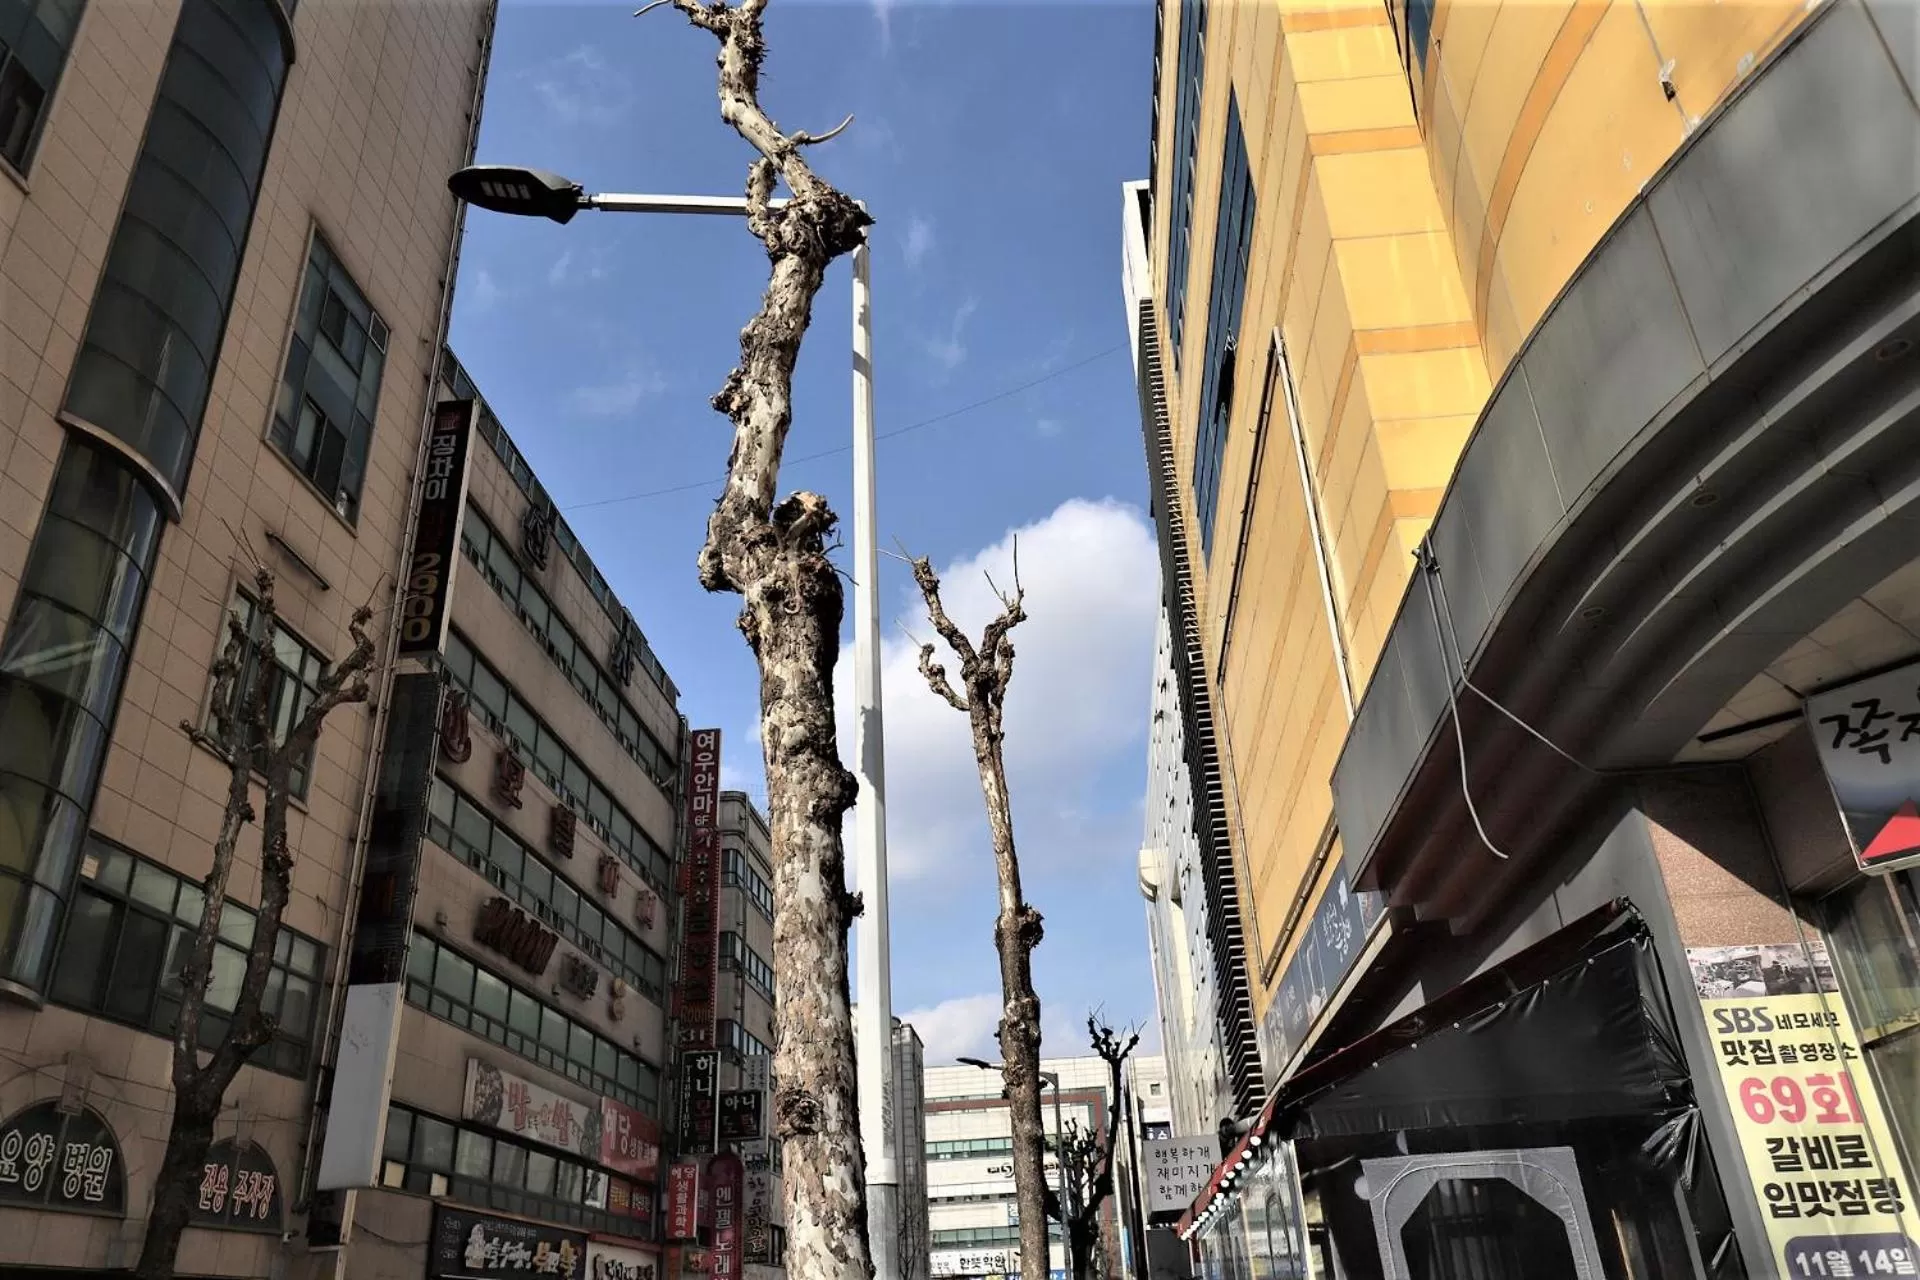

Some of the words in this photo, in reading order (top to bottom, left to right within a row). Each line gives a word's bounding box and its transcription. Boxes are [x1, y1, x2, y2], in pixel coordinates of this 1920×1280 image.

[403, 553, 441, 642] 2900
[693, 731, 715, 814] 여우안마
[1712, 1006, 1774, 1034] SBS
[1775, 1012, 1841, 1031] 네모세모
[1720, 1039, 1777, 1066] 맛집
[1778, 1042, 1859, 1065] 촬영장소
[1739, 1071, 1865, 1125] 69회
[0, 1129, 55, 1192] 요양
[63, 1142, 113, 1202] 병원
[1765, 1134, 1873, 1173] 갈비로
[198, 1163, 229, 1214] 전용
[233, 1169, 275, 1220] 주차장
[1763, 1177, 1905, 1219] 입맛점령
[714, 1186, 734, 1280] 엔젤노래
[1795, 1250, 1854, 1277] 11월
[1859, 1247, 1916, 1276] 14일
